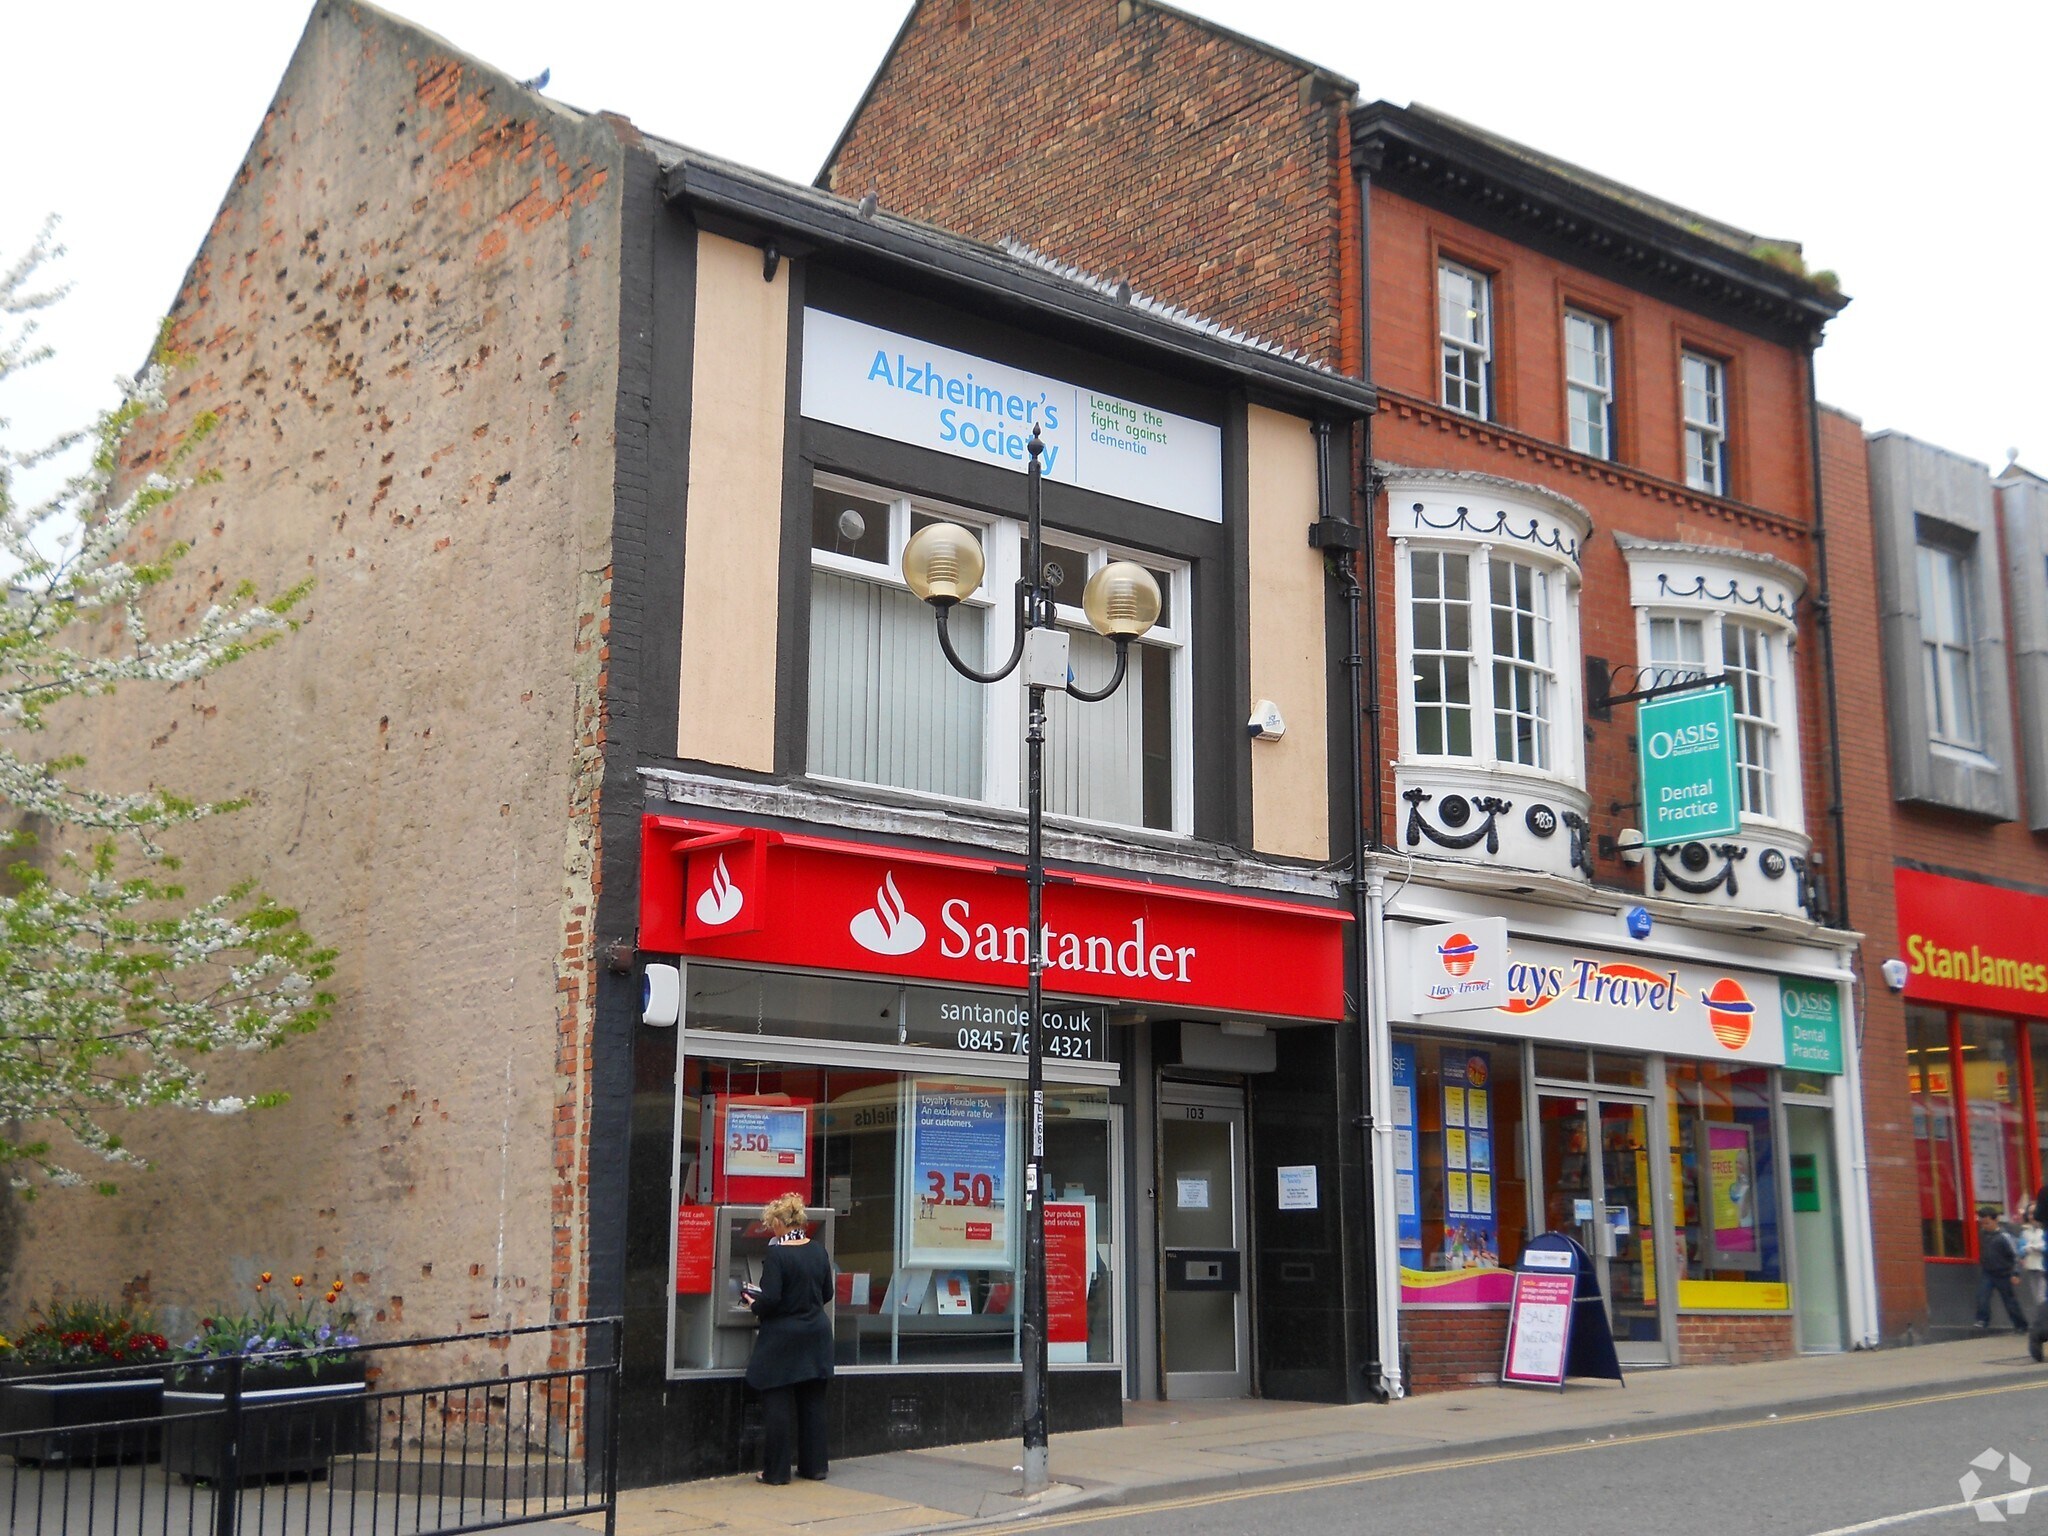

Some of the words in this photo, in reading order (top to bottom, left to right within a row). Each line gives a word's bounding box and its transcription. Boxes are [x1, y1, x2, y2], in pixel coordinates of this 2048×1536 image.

[867, 350, 1059, 430] Alzheimer's
[1090, 395, 1136, 422] Leading
[1143, 411, 1163, 427] the
[1091, 412, 1119, 430] fight
[1125, 425, 1167, 445] against
[1091, 429, 1147, 455] dementia
[1661, 778, 1713, 802] Dental
[1659, 801, 1718, 822] Practice
[940, 898, 1196, 984] Santander
[1907, 934, 2048, 993] StanJames
[1430, 984, 1455, 996] Hays
[1459, 979, 1491, 993] Travel
[1508, 963, 1563, 1006] ays
[1572, 959, 1678, 1012] Travel
[941, 1002, 1092, 1033] santandeco.uk
[957, 1027, 1003, 1052] 0845
[1011, 1032, 1044, 1055] 76
[1050, 1035, 1092, 1058] 4321
[1793, 1025, 1826, 1042] Dental
[1792, 1043, 1830, 1060] Practice
[921, 1106, 932, 1115] An
[934, 1107, 966, 1117] exclusive
[967, 1110, 981, 1118] rate
[982, 1109, 993, 1119] for
[922, 1095, 948, 1107] Loyalty
[949, 1097, 976, 1107] Flexible
[977, 1099, 992, 1109] ISA.
[921, 1118, 934, 1126] our
[935, 1119, 974, 1128] customers.
[1186, 1107, 1205, 1120] 103
[731, 1133, 769, 1152] 3.50
[1712, 1160, 1733, 1173] FREE
[927, 1170, 993, 1207] 3.50
[1044, 1210, 1056, 1218] Our
[1056, 1211, 1082, 1219] products
[1044, 1218, 1056, 1226] and
